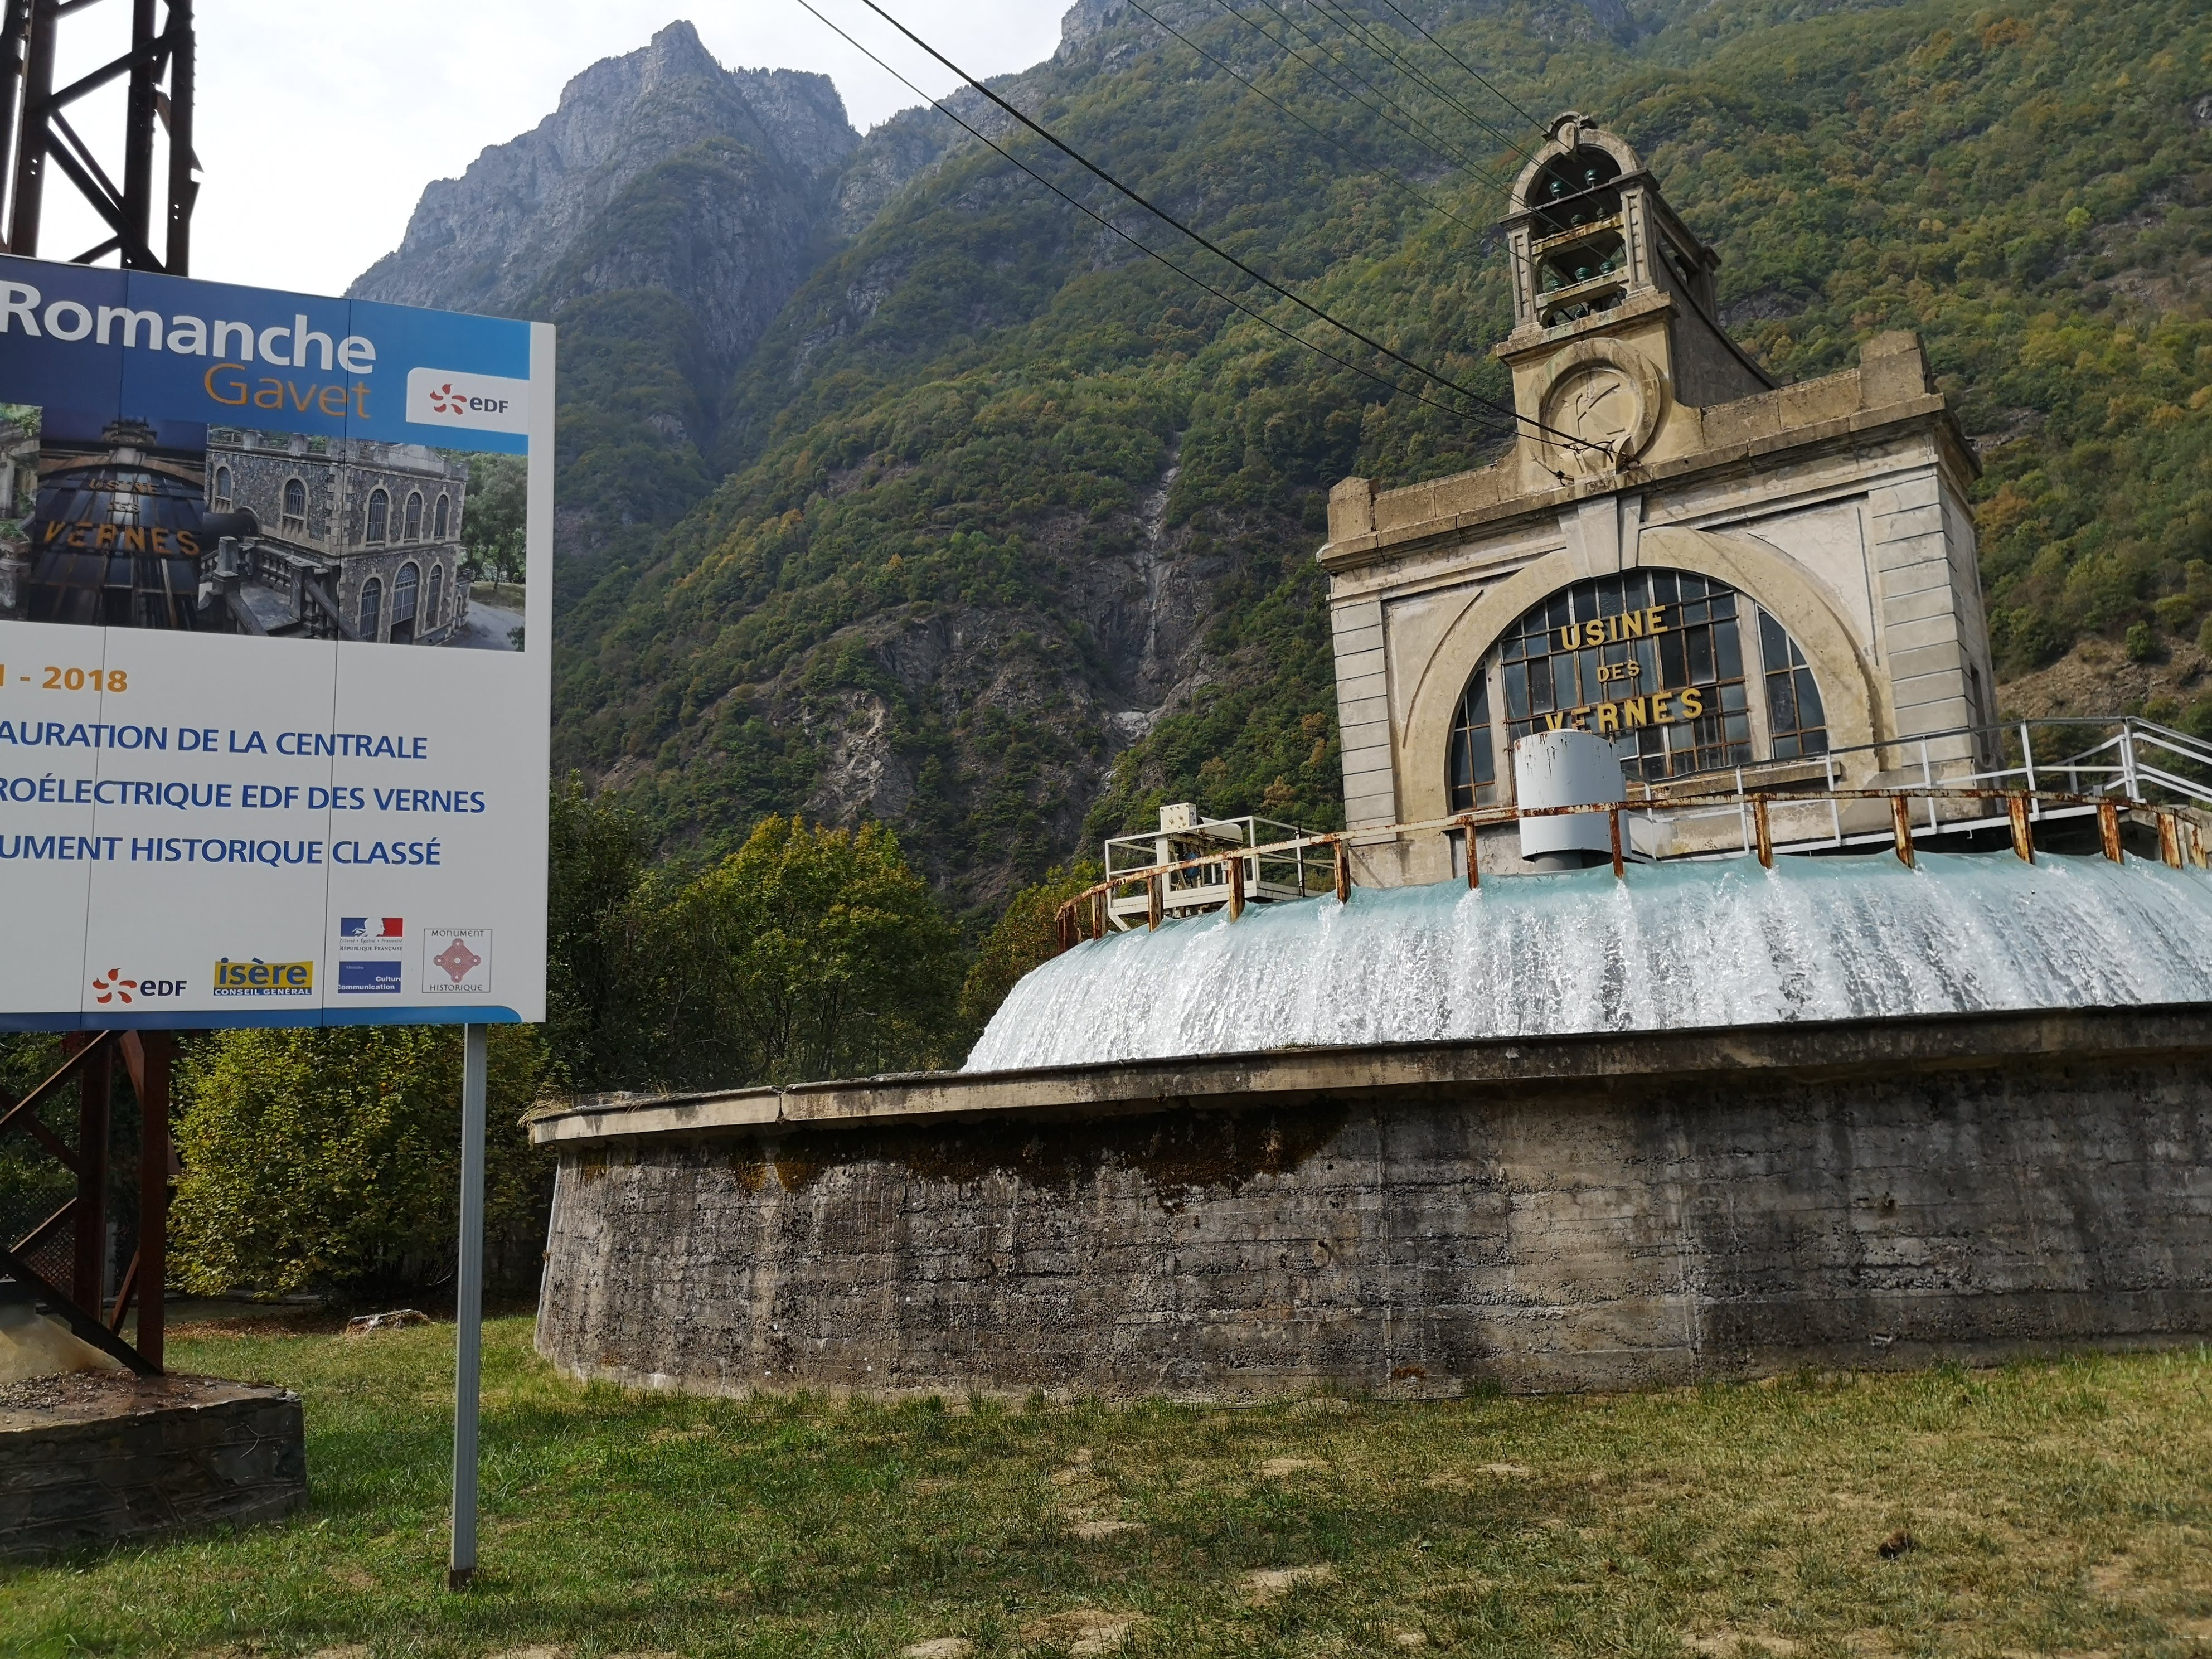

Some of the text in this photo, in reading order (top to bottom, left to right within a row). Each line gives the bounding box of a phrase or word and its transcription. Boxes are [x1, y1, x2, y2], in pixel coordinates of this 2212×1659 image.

[0, 280, 376, 374] Romanche
[205, 363, 371, 419] Gavet
[44, 520, 200, 556] VERNES
[1561, 605, 1668, 651] USINE
[43, 667, 128, 692] 2018
[1598, 660, 1639, 682] DES
[1545, 688, 1703, 733] VERNES
[0, 721, 427, 759] AURATION DE LA CENTRALE
[242, 785, 299, 808] EDF
[308, 787, 365, 810] DES
[374, 788, 485, 813] VERNES
[0, 835, 441, 867] UMENT HISTORIQUE CLASSÉ
[220, 957, 307, 985] isère
